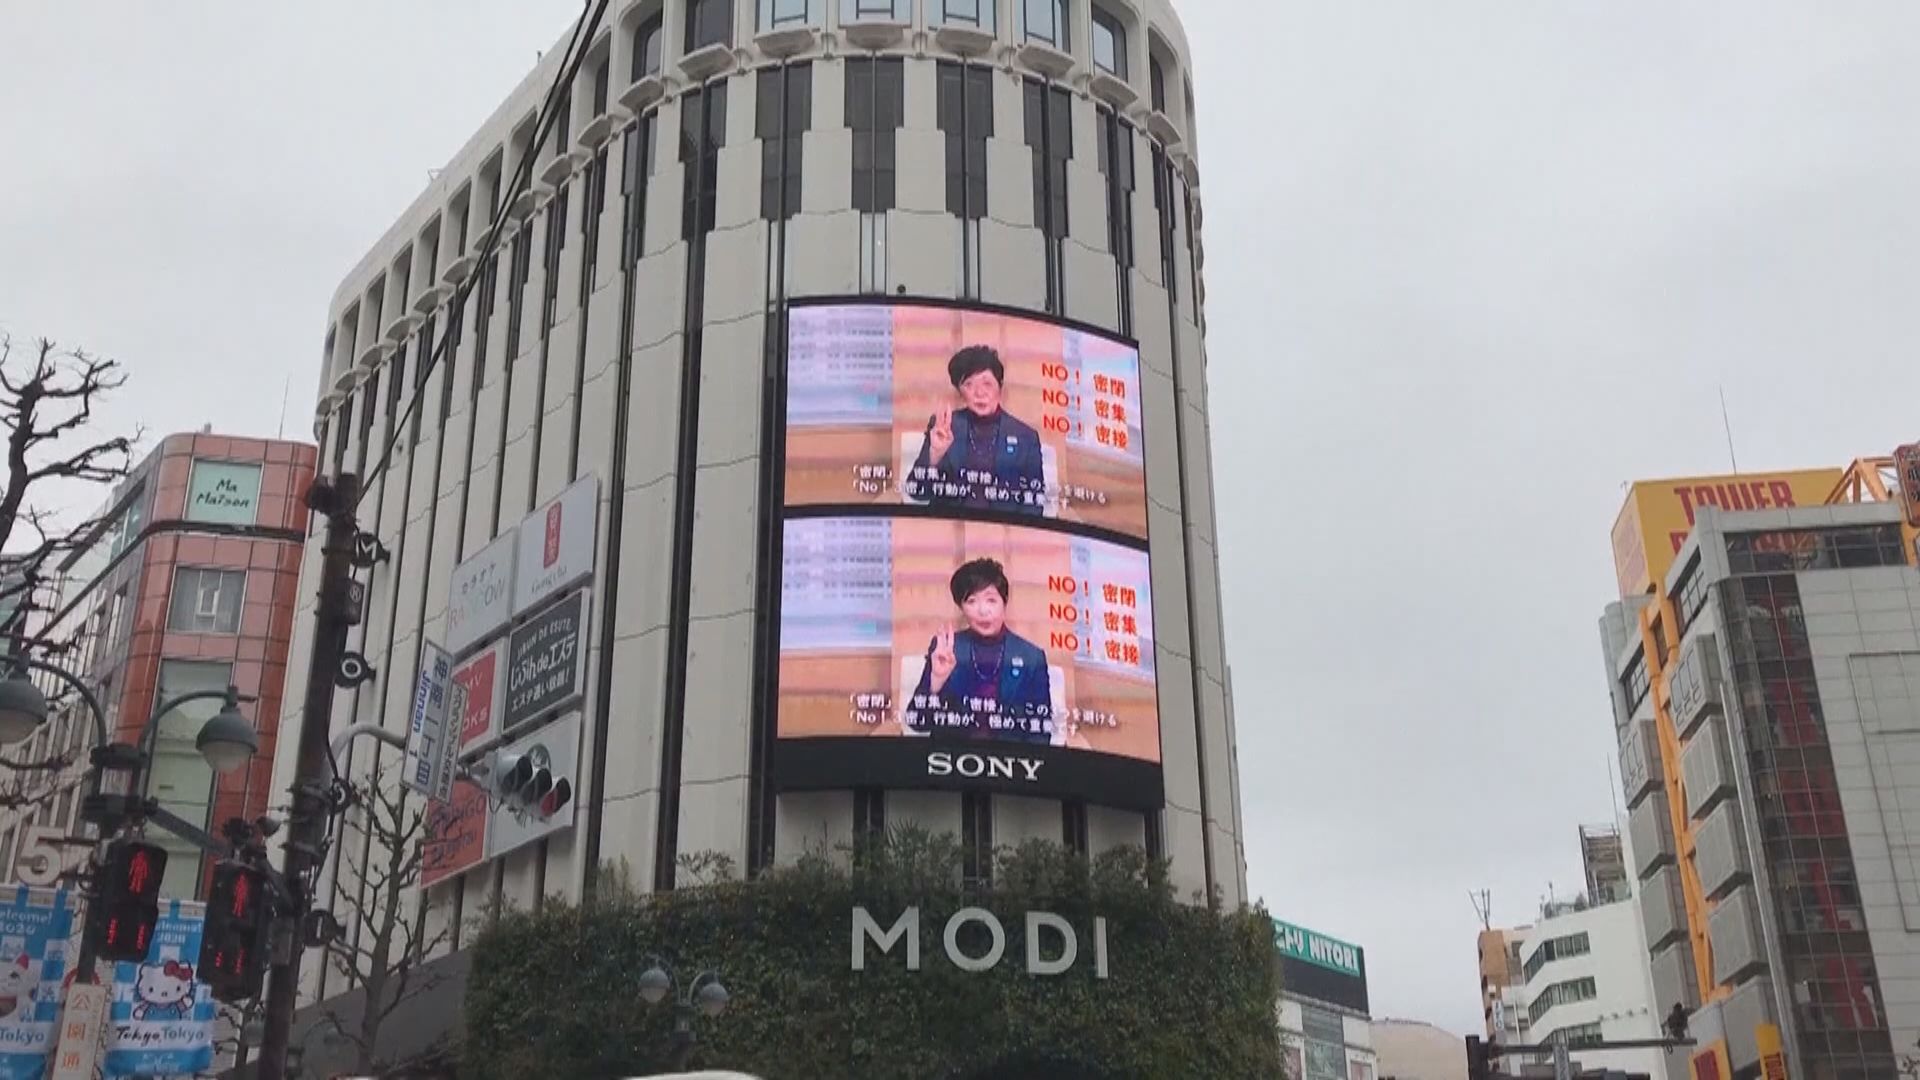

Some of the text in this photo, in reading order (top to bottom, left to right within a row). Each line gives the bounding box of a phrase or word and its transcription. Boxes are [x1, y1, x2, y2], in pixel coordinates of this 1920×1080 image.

[1095, 399, 1126, 423] 密集
[196, 492, 249, 508] Maison
[216, 478, 237, 492] Ma
[1674, 481, 1796, 527] TOWER
[1104, 611, 1137, 637] 密集
[413, 671, 431, 734] Jinnan
[927, 752, 1044, 781] SONY
[16, 826, 63, 886] 5
[851, 905, 1109, 979] MODI
[1309, 933, 1359, 971] NITORI
